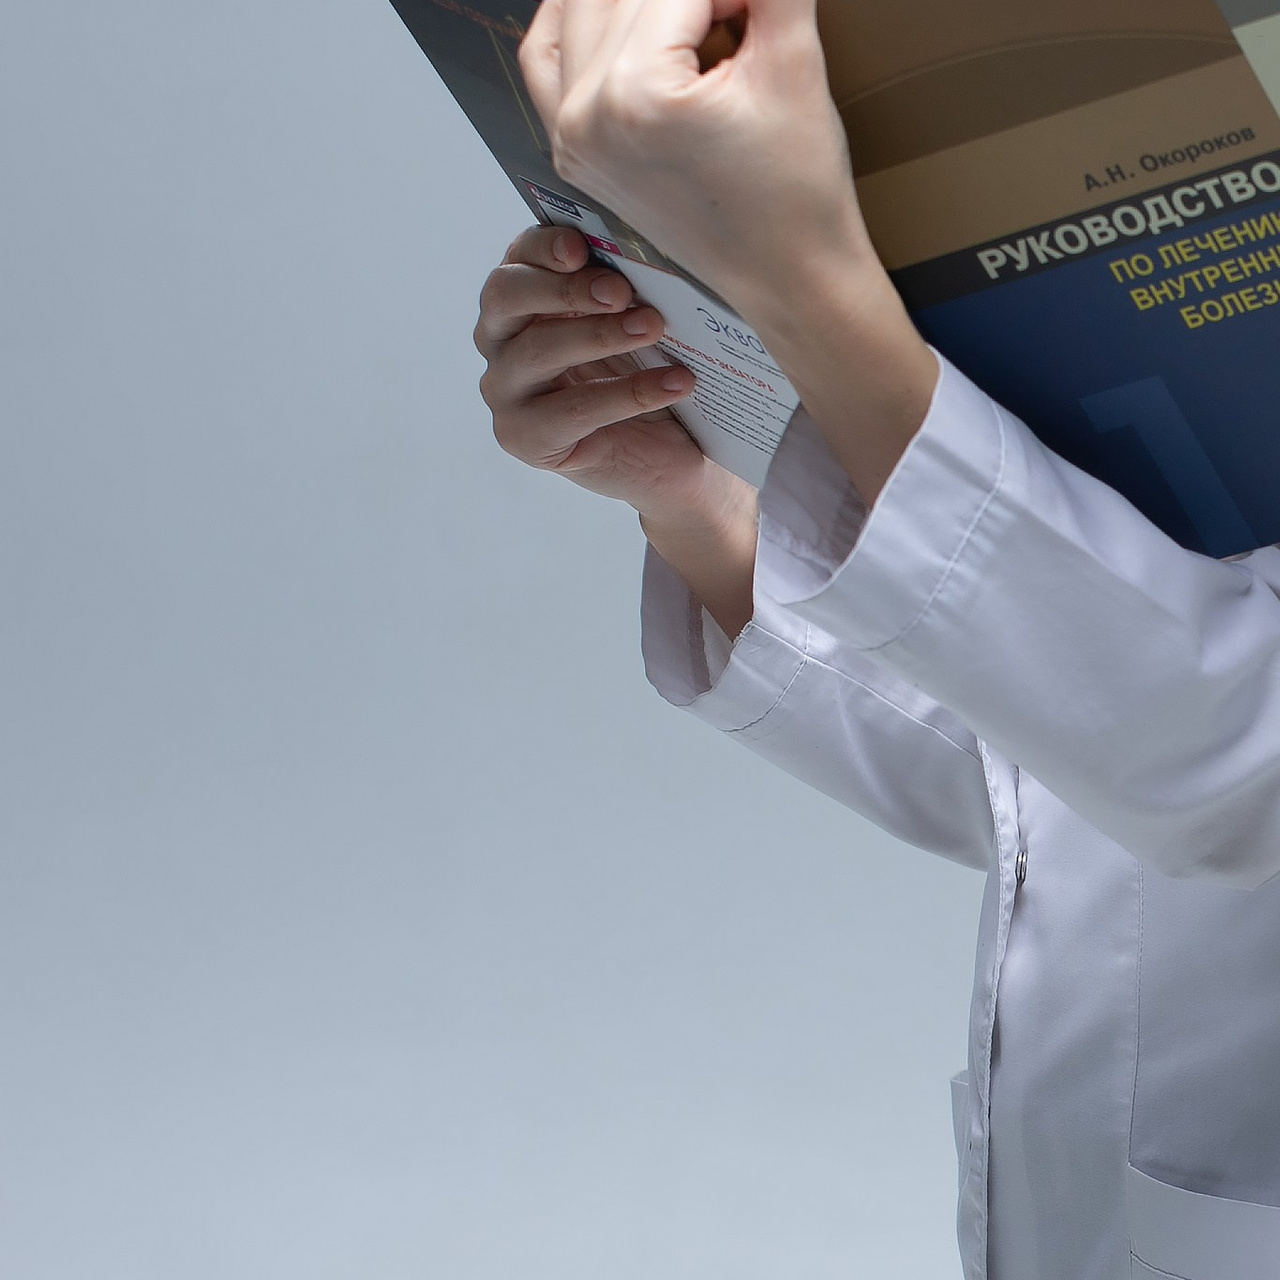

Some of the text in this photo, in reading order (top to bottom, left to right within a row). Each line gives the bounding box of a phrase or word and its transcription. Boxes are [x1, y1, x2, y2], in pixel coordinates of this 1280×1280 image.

[1084, 127, 1256, 192] А.Н. Окороков
[1109, 253, 1155, 284] ПО
